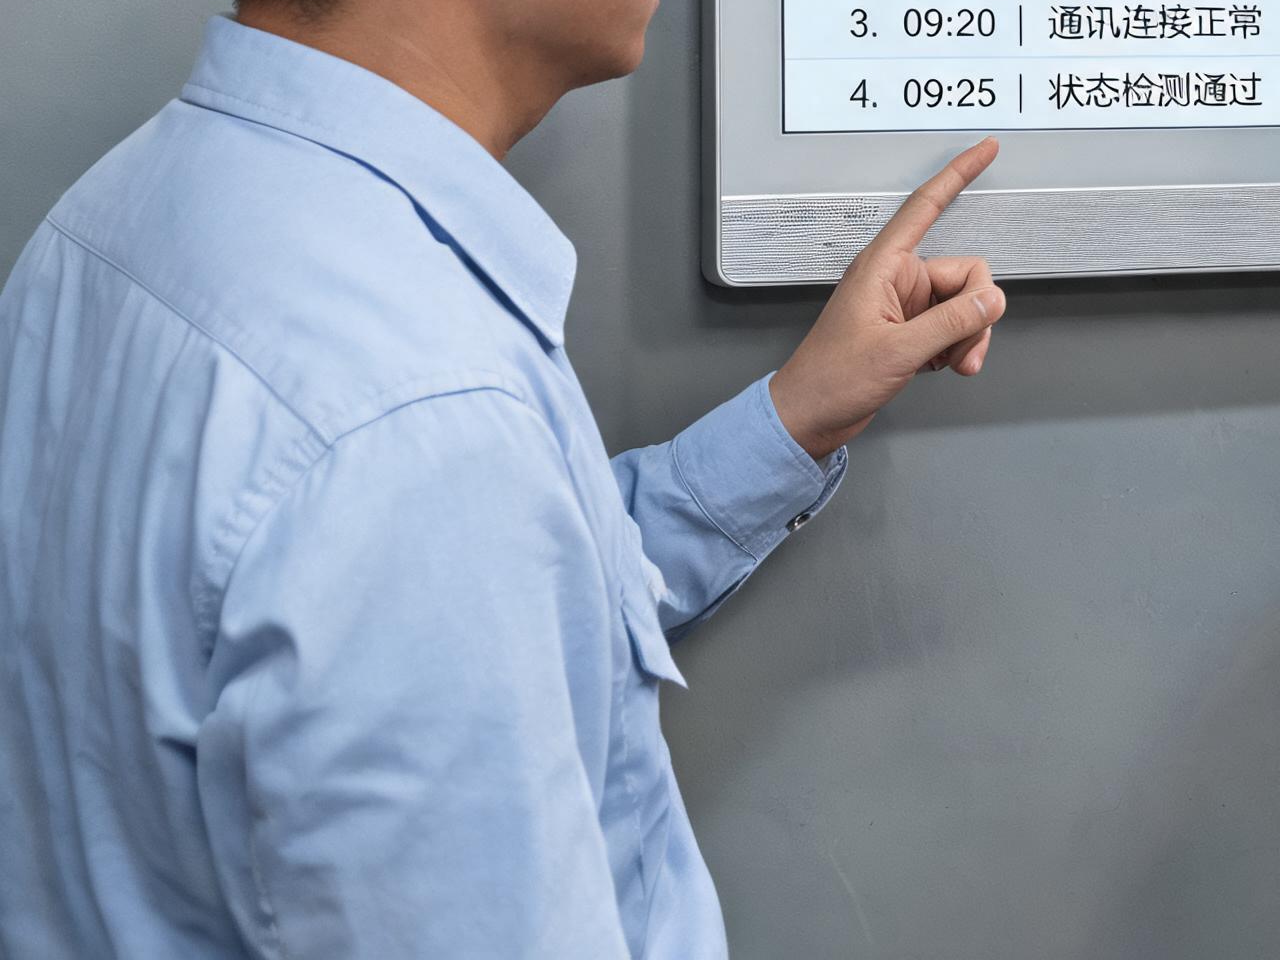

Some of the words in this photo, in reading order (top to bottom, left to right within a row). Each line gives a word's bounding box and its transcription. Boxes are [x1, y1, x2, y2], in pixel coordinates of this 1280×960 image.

[850, 8, 877, 38] 3.
[903, 8, 996, 38] 09:20
[1048, 4, 1262, 40] 通讯连接正常
[849, 78, 878, 109] 4.
[903, 78, 996, 108] 09:25
[1048, 72, 1262, 110] 状态检测通过
